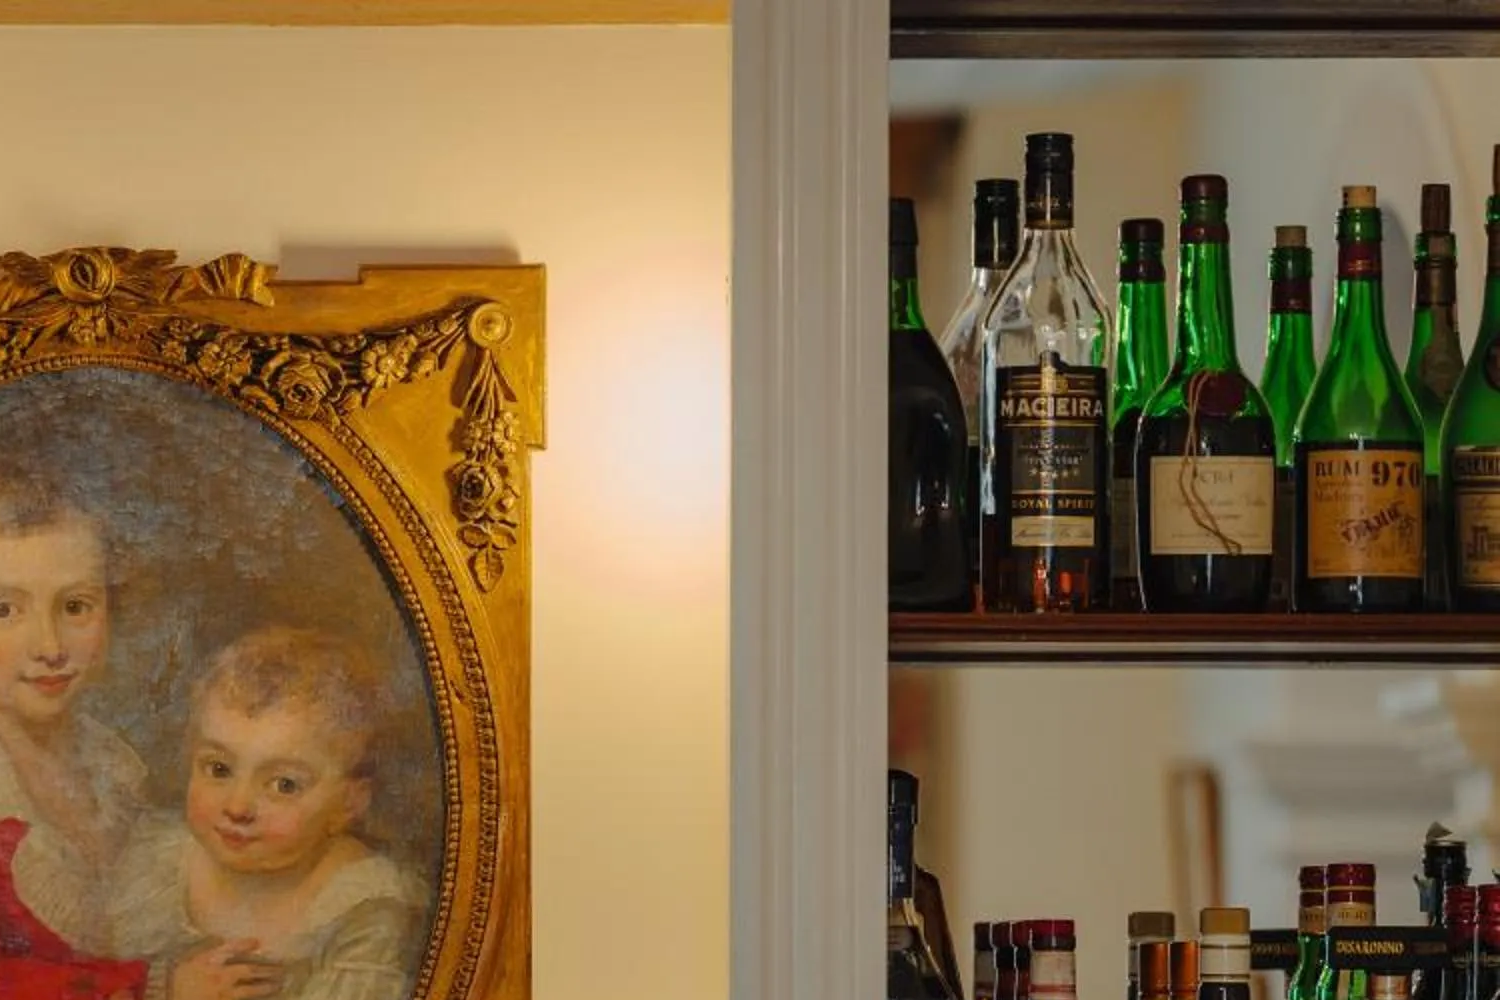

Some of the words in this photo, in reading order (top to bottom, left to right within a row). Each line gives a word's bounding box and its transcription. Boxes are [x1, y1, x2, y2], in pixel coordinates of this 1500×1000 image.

[1000, 396, 1104, 418] MACIEIRA
[1315, 460, 1360, 477] RUM
[1371, 460, 1421, 488] 970
[1335, 940, 1405, 955] DISARONNO
